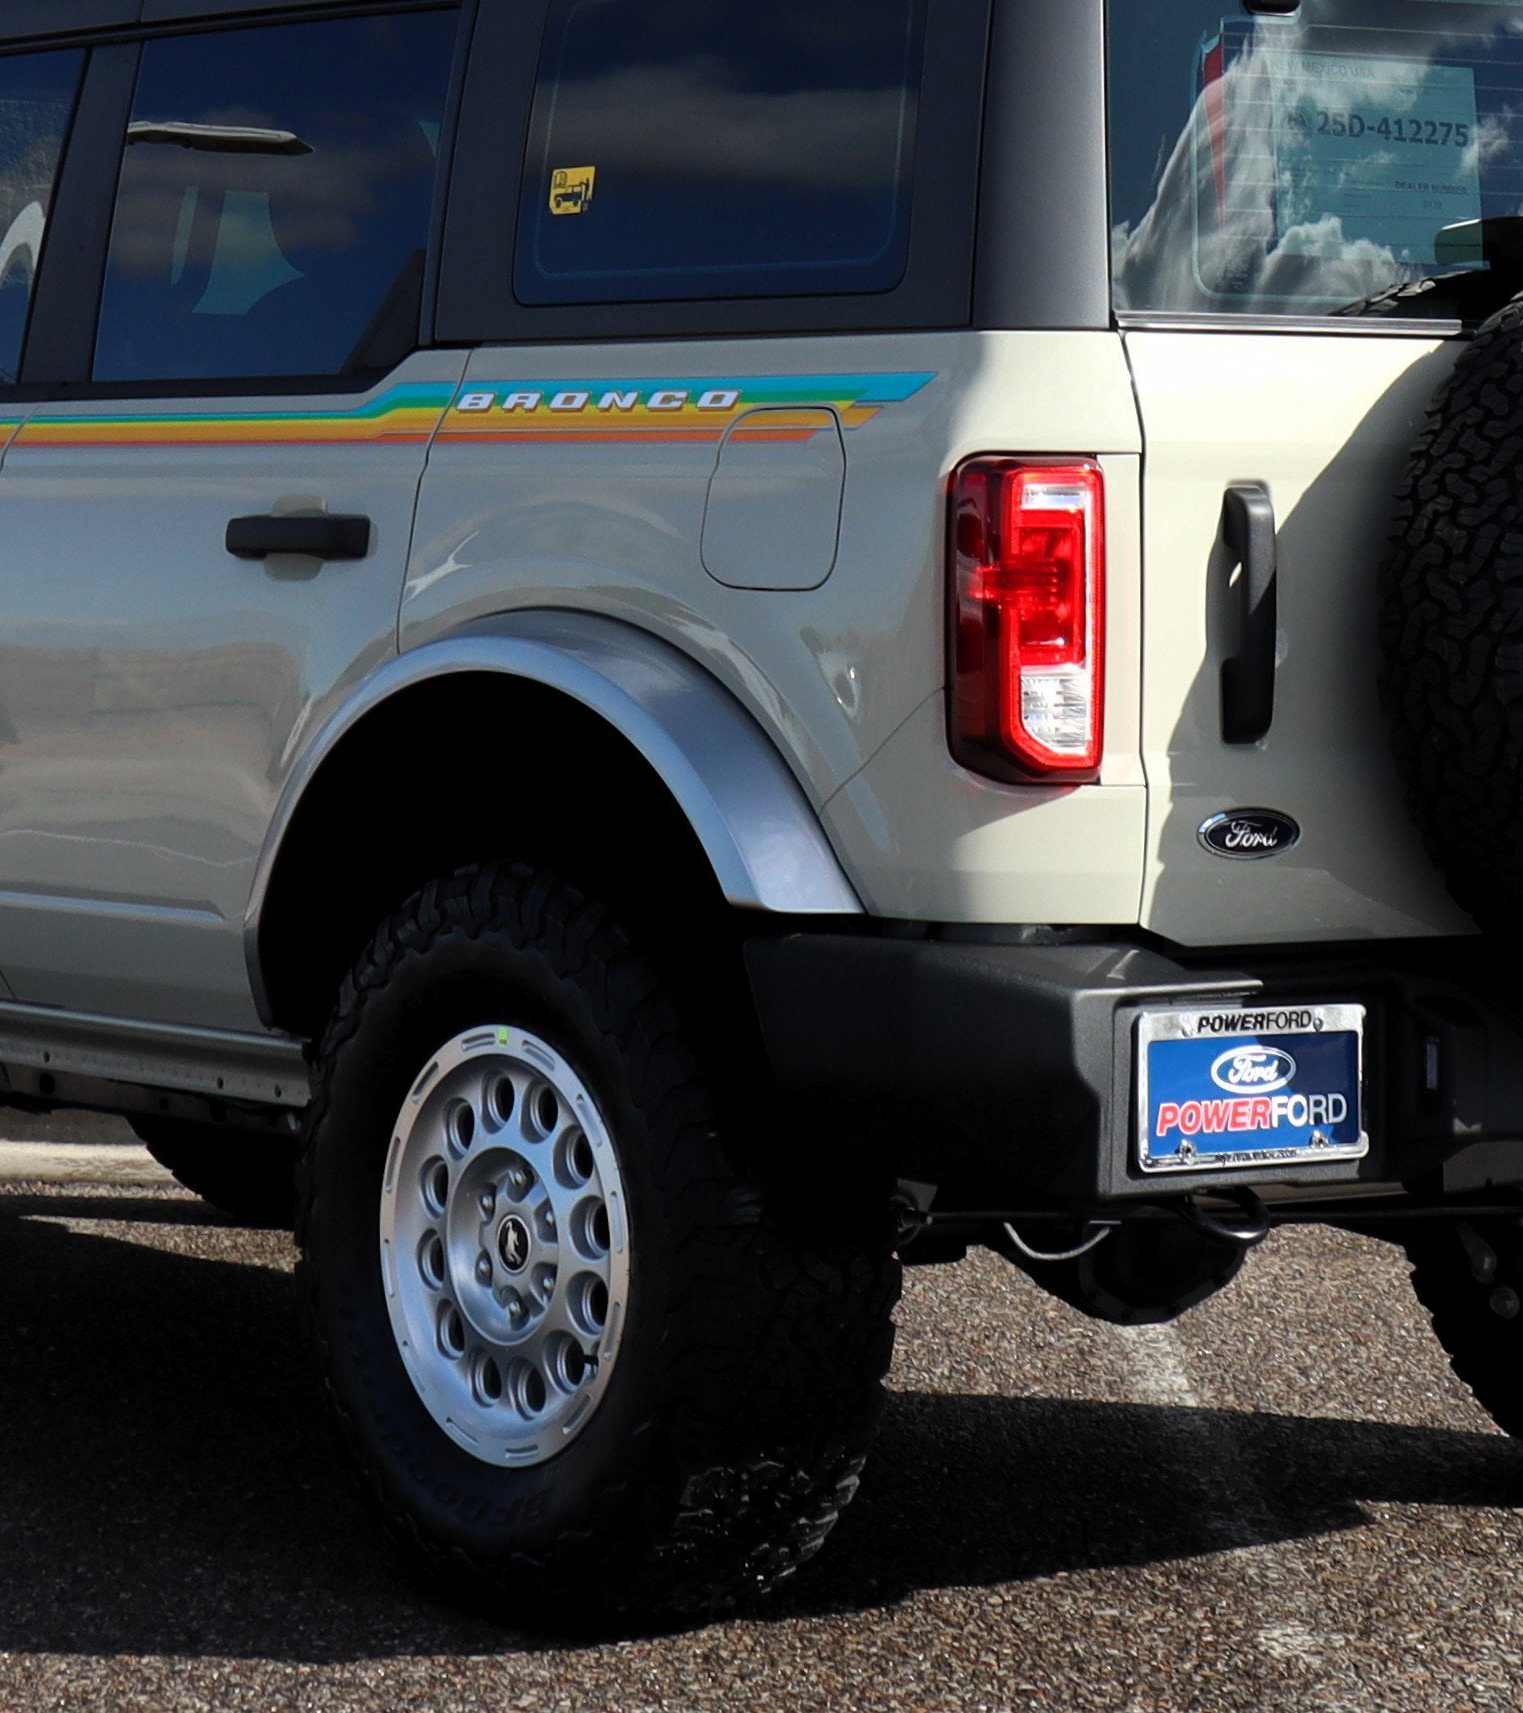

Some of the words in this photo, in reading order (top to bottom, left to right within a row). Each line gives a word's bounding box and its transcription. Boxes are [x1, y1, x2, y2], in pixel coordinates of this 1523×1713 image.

[1351, 66, 1377, 79] USA
[1315, 110, 1470, 148] 25D-412275
[455, 389, 742, 413] BRONCO
[1224, 820, 1278, 849] Ford
[1197, 1009, 1312, 1034] POWERFORD
[1227, 1053, 1279, 1084] Ford
[1156, 1092, 1348, 1137] POWERFORD
